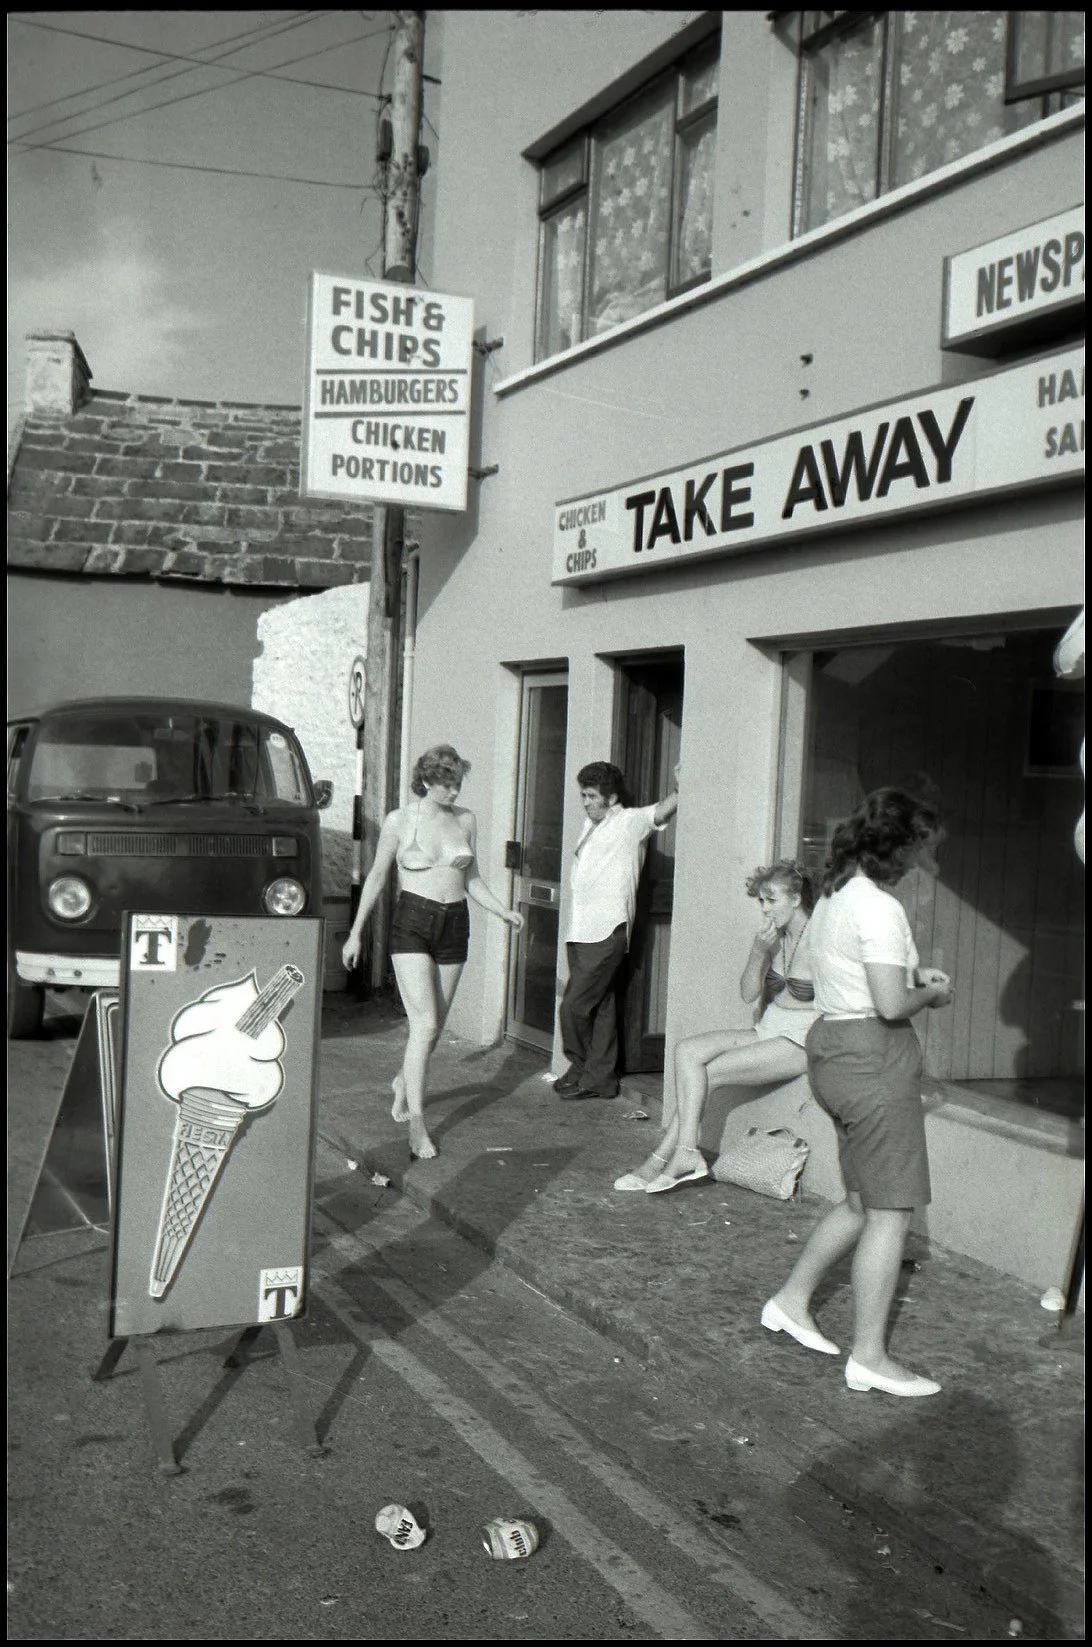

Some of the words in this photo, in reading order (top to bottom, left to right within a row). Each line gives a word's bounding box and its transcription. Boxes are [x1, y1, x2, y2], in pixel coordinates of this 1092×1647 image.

[976, 231, 1085, 318] NEWSP
[332, 286, 414, 327] FISH
[422, 302, 445, 331] &
[331, 325, 441, 368] CHIPS
[320, 379, 459, 405] HAMBURGERS
[1038, 365, 1085, 408] HA
[351, 419, 446, 454] CHICKEN
[1045, 419, 1085, 459] SA
[331, 453, 443, 488] PORTIONS
[626, 462, 754, 552] TAKE
[782, 396, 975, 519] AWAY
[559, 500, 606, 531] CHICKEN
[578, 528, 586, 549] &
[566, 548, 597, 573] CHIPS
[135, 929, 173, 966] T
[264, 1286, 299, 1320] T
[510, 1530, 527, 1556] club
